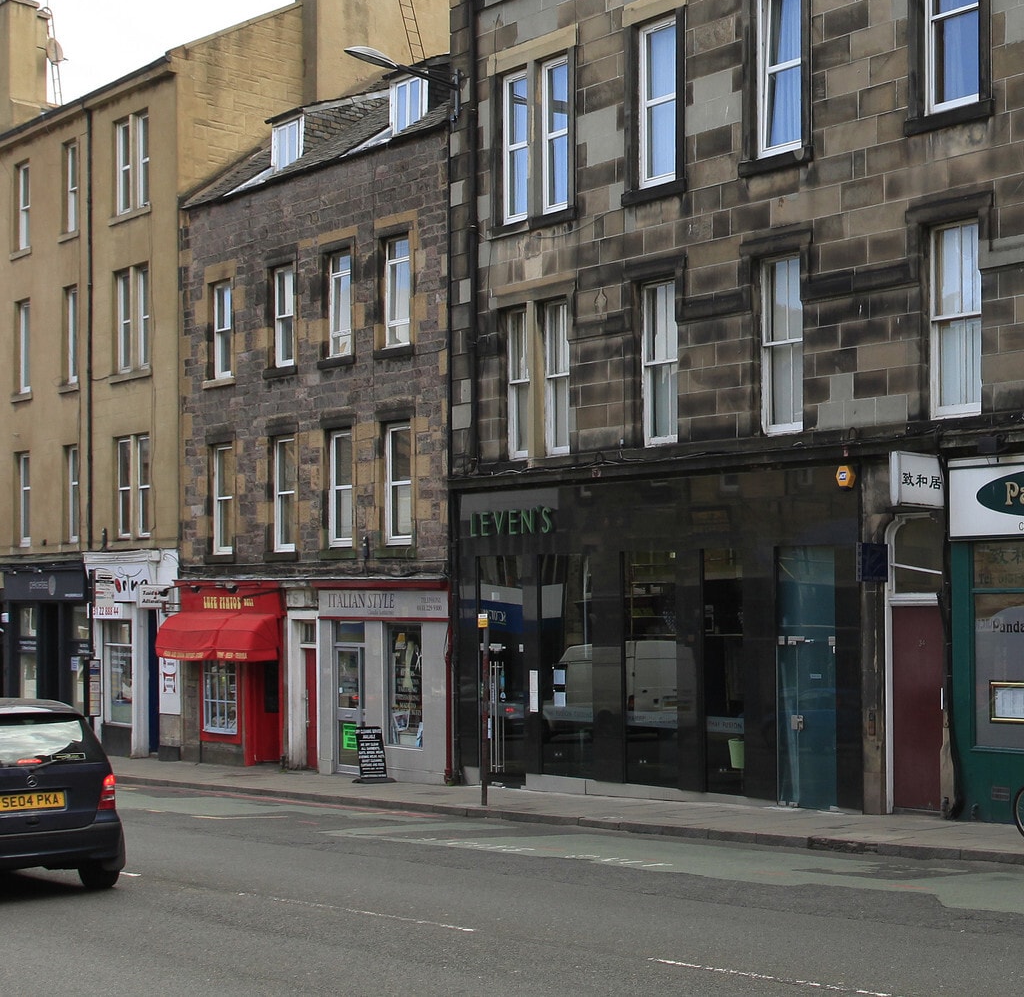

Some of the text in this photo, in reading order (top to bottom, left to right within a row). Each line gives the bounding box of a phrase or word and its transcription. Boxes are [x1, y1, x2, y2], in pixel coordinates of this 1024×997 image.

[901, 472, 942, 490] 致和居
[470, 505, 553, 537] LEVEN'S
[328, 593, 395, 609] ITALIAN STYLE
[2, 793, 60, 808] SE04 PKA
